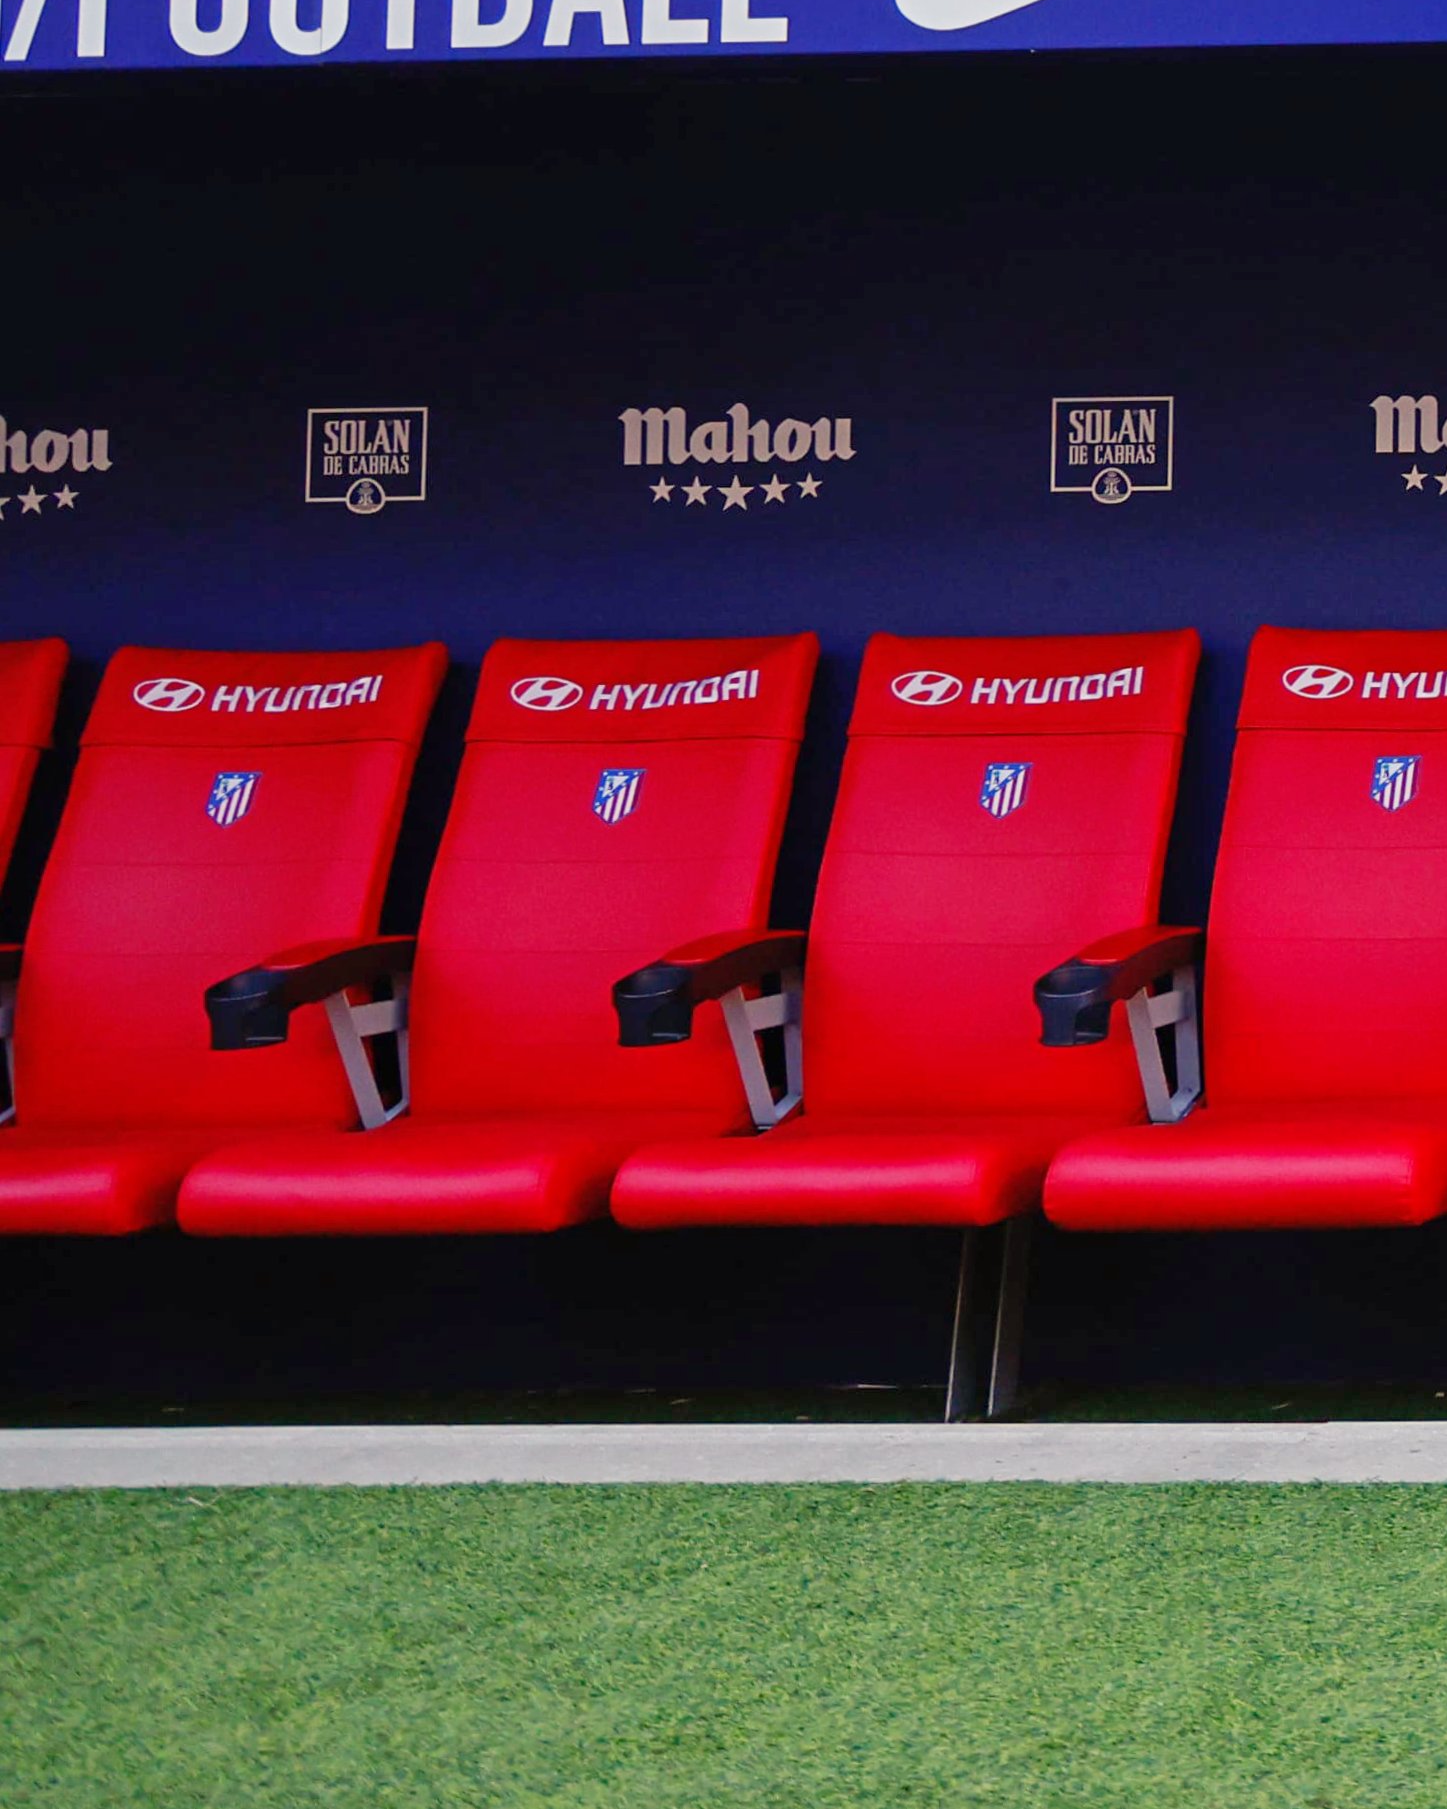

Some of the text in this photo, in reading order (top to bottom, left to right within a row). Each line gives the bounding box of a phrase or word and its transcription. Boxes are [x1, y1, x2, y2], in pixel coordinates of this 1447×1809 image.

[324, 420, 410, 454] SOLAN
[619, 403, 856, 465] Mahou
[1069, 409, 1156, 443] SOLAN
[324, 455, 409, 475] DE CABRAS
[1069, 444, 1155, 465] DE CABRAS
[212, 676, 382, 711] HYUNDAI
[590, 670, 758, 709] HYUNDAI
[971, 667, 1143, 704] HYUNDAI
